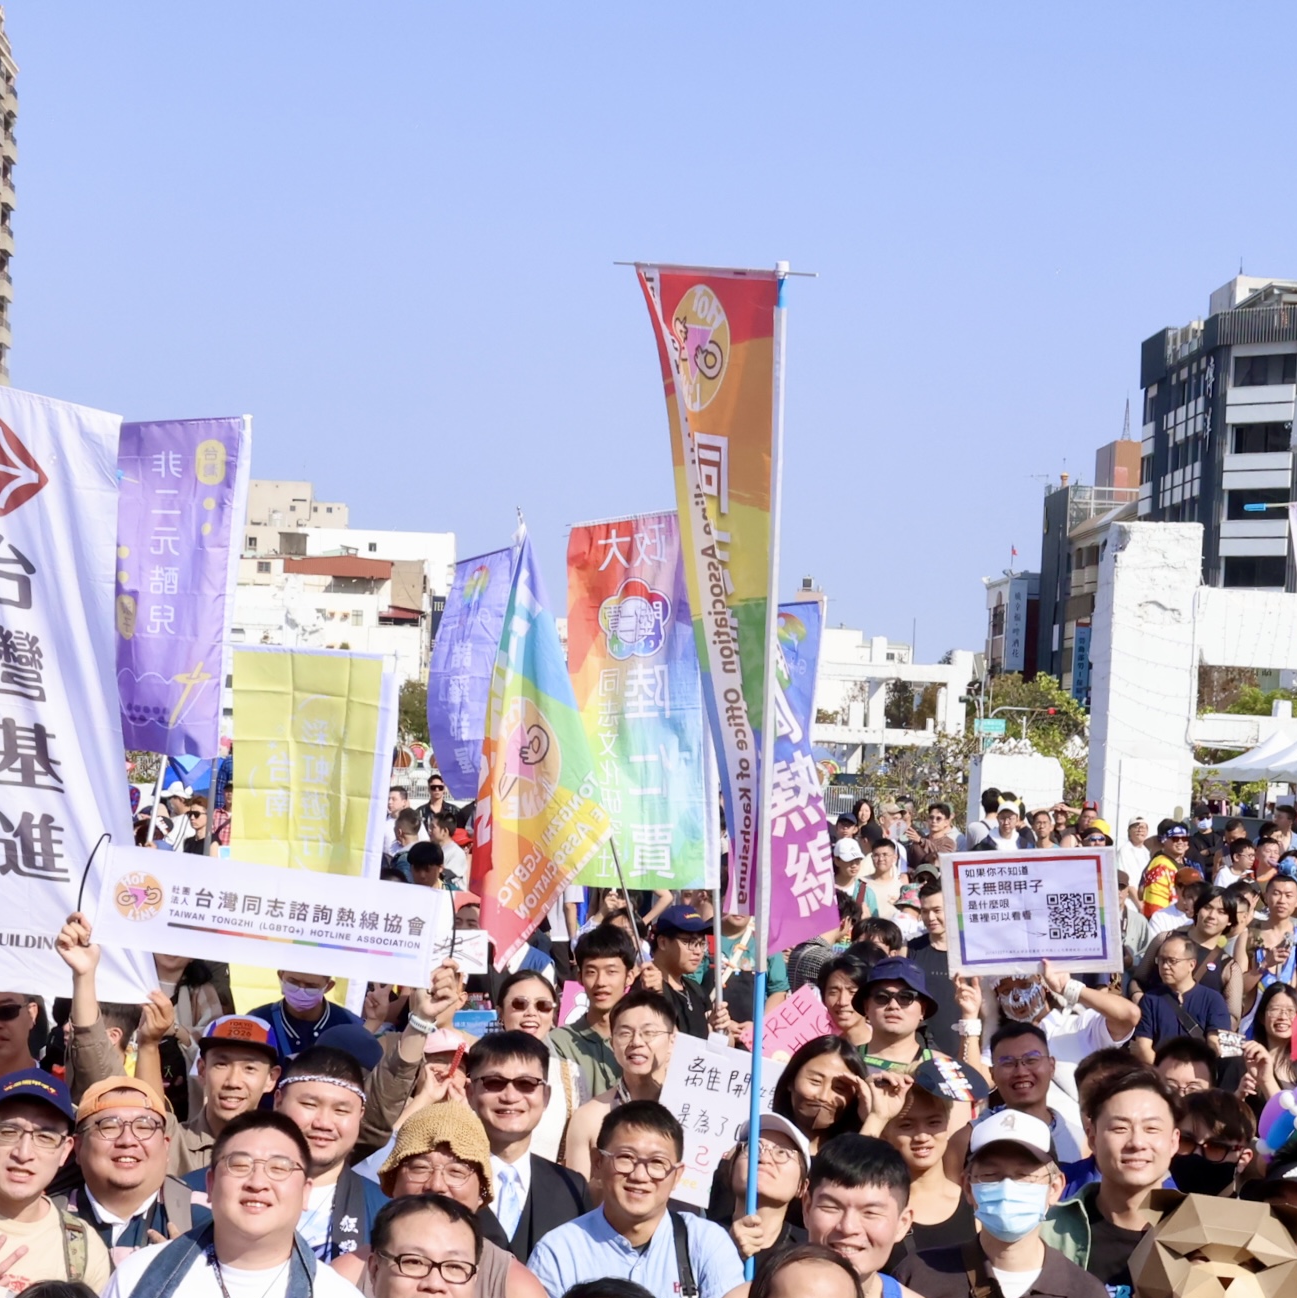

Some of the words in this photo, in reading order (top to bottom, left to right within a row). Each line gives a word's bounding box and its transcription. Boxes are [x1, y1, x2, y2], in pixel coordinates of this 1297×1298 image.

[965, 865, 1029, 878] 如果你不知道
[171, 884, 192, 896] 社團
[967, 879, 1044, 897] 天無照甲子
[170, 895, 190, 907] 法人
[194, 887, 428, 937] 台灣同志諮詢熱線協會
[969, 910, 1032, 924] 這裡可以看看
[169, 909, 205, 922] TAIWAN
[211, 915, 253, 929] TONGZHI
[258, 921, 305, 936] (LGBTQ+)
[310, 928, 352, 942] HOTLINE
[356, 934, 421, 950] ASSOCIATION
[227, 1029, 252, 1037] 2026
